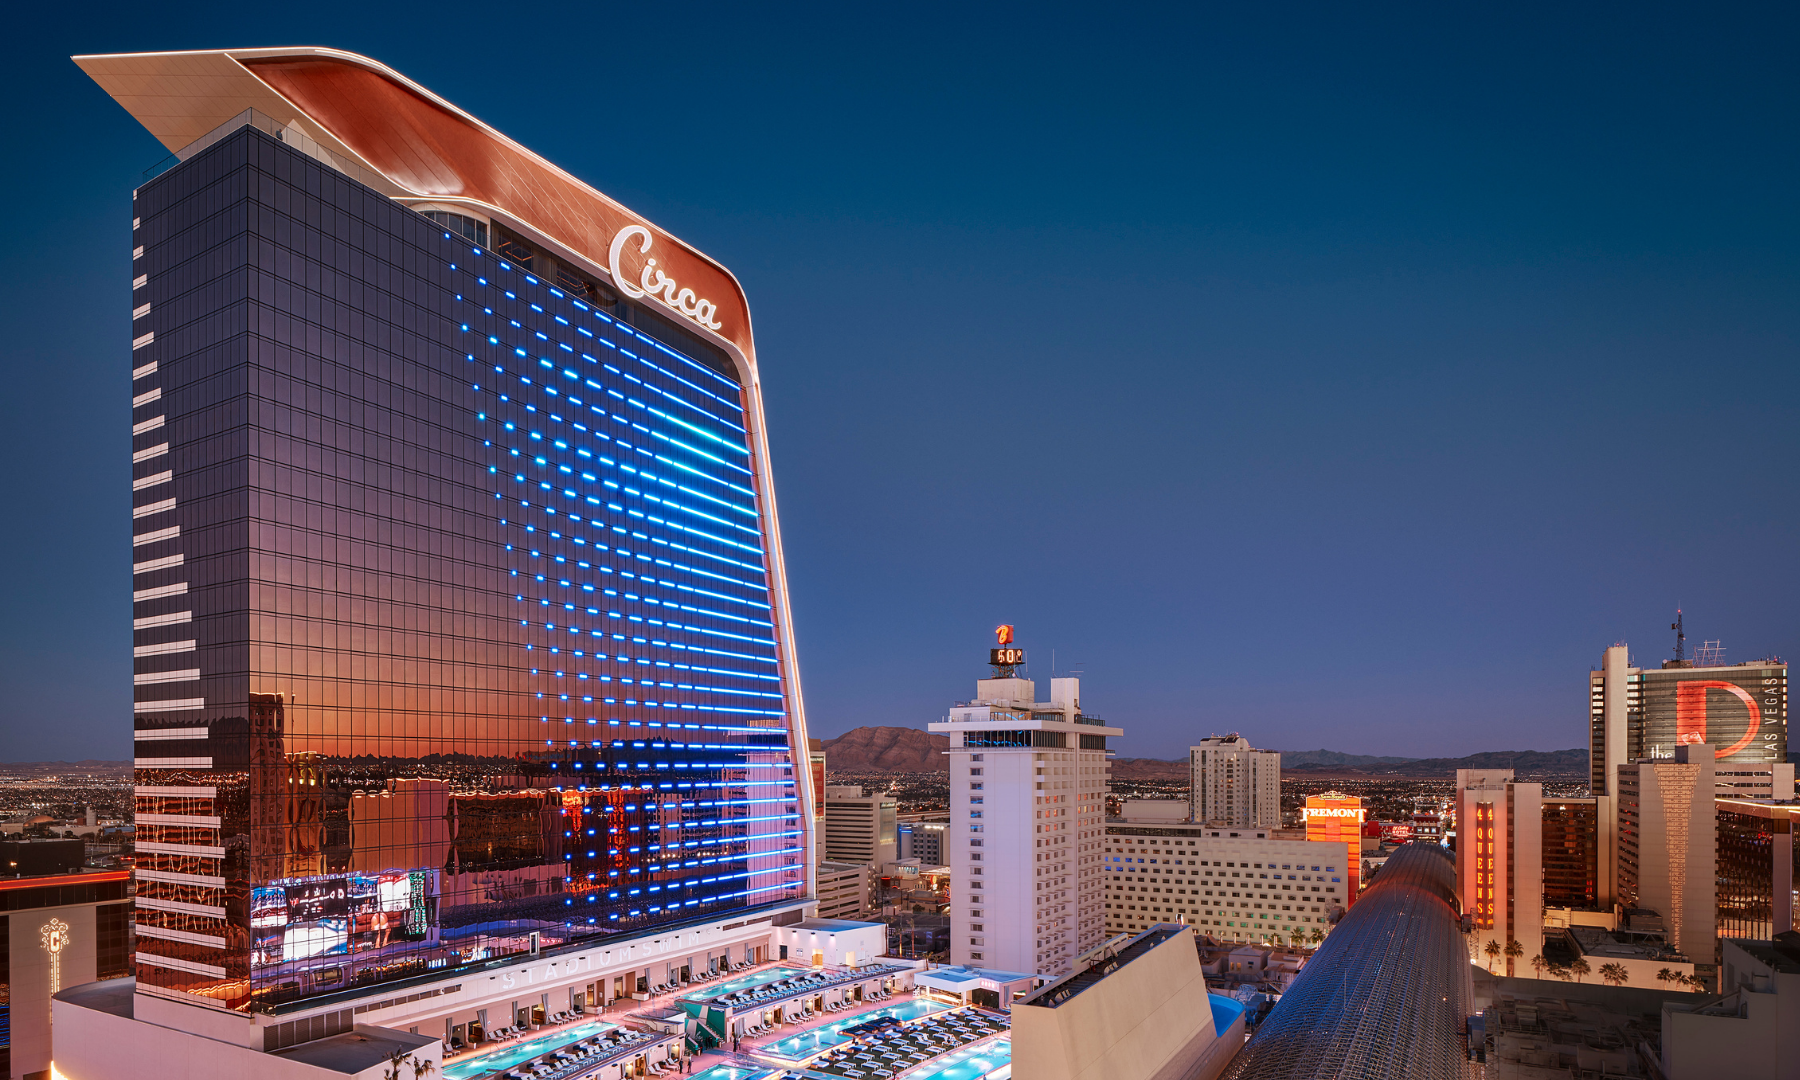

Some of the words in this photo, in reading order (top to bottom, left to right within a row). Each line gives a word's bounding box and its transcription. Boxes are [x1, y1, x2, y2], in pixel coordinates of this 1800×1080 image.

[609, 224, 722, 330] Circa
[995, 625, 1009, 644] B
[1764, 677, 1778, 725] VEGAS
[1650, 744, 1673, 759] the
[1676, 680, 1761, 759] D
[1764, 733, 1778, 760] LAS
[1301, 808, 1367, 822] FREMONT
[1477, 808, 1483, 820] 4
[1487, 808, 1493, 820] 4
[502, 945, 632, 989] STADIUM
[642, 932, 701, 958] SWIM
